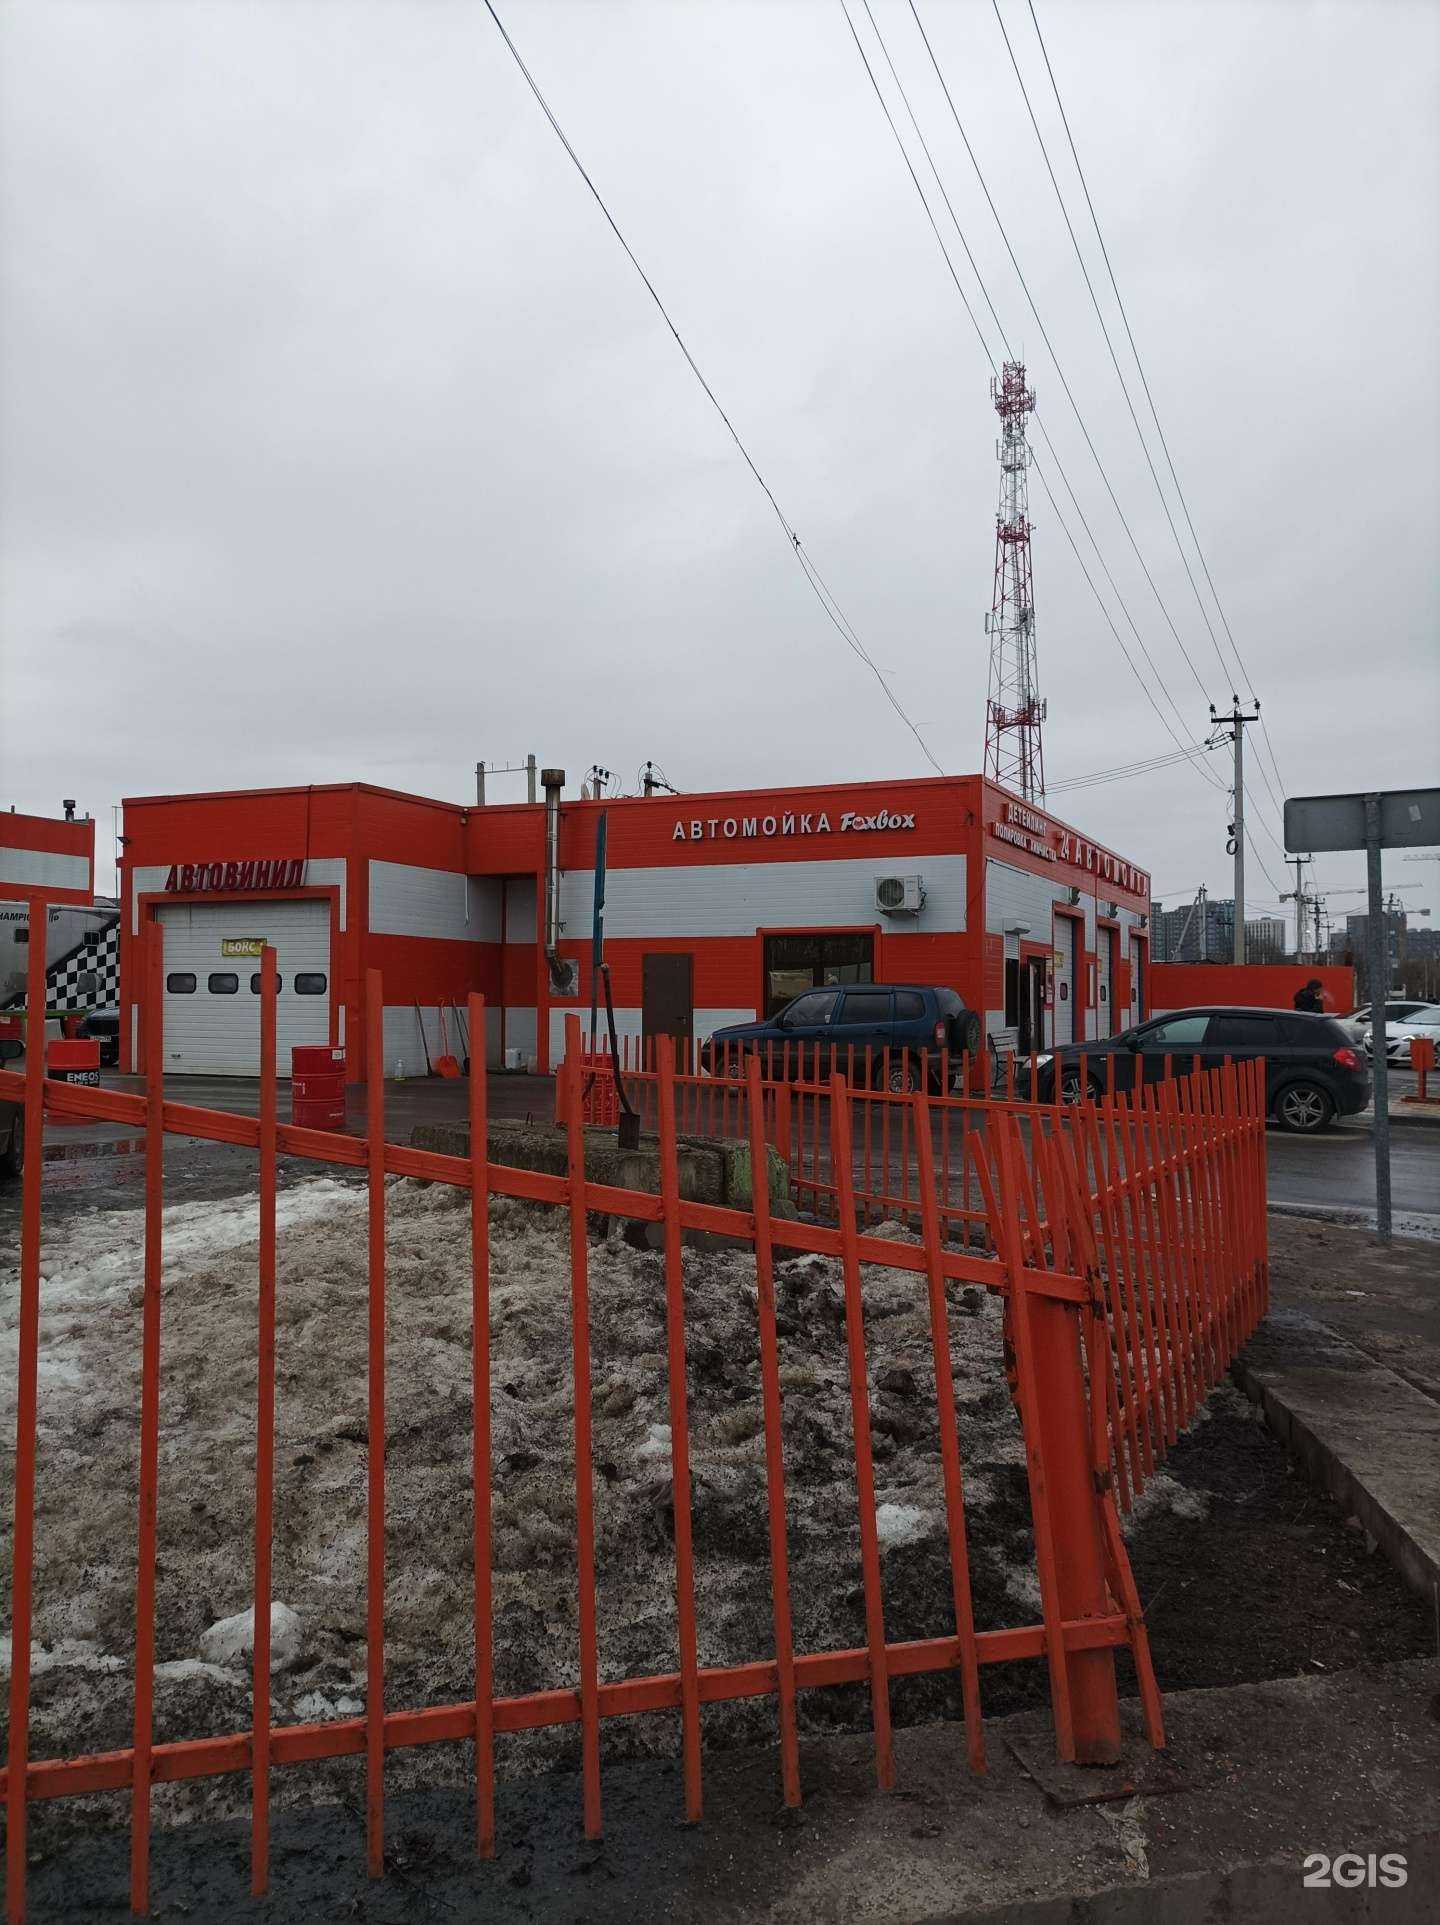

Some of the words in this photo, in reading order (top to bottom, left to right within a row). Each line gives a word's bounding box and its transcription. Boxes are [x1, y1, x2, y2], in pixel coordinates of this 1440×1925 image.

[672, 810, 831, 840] АВТОМОЙКА
[165, 859, 305, 891] АВТОВИНИЛ
[227, 941, 256, 953] БОКС
[67, 1071, 99, 1082] ENEOS
